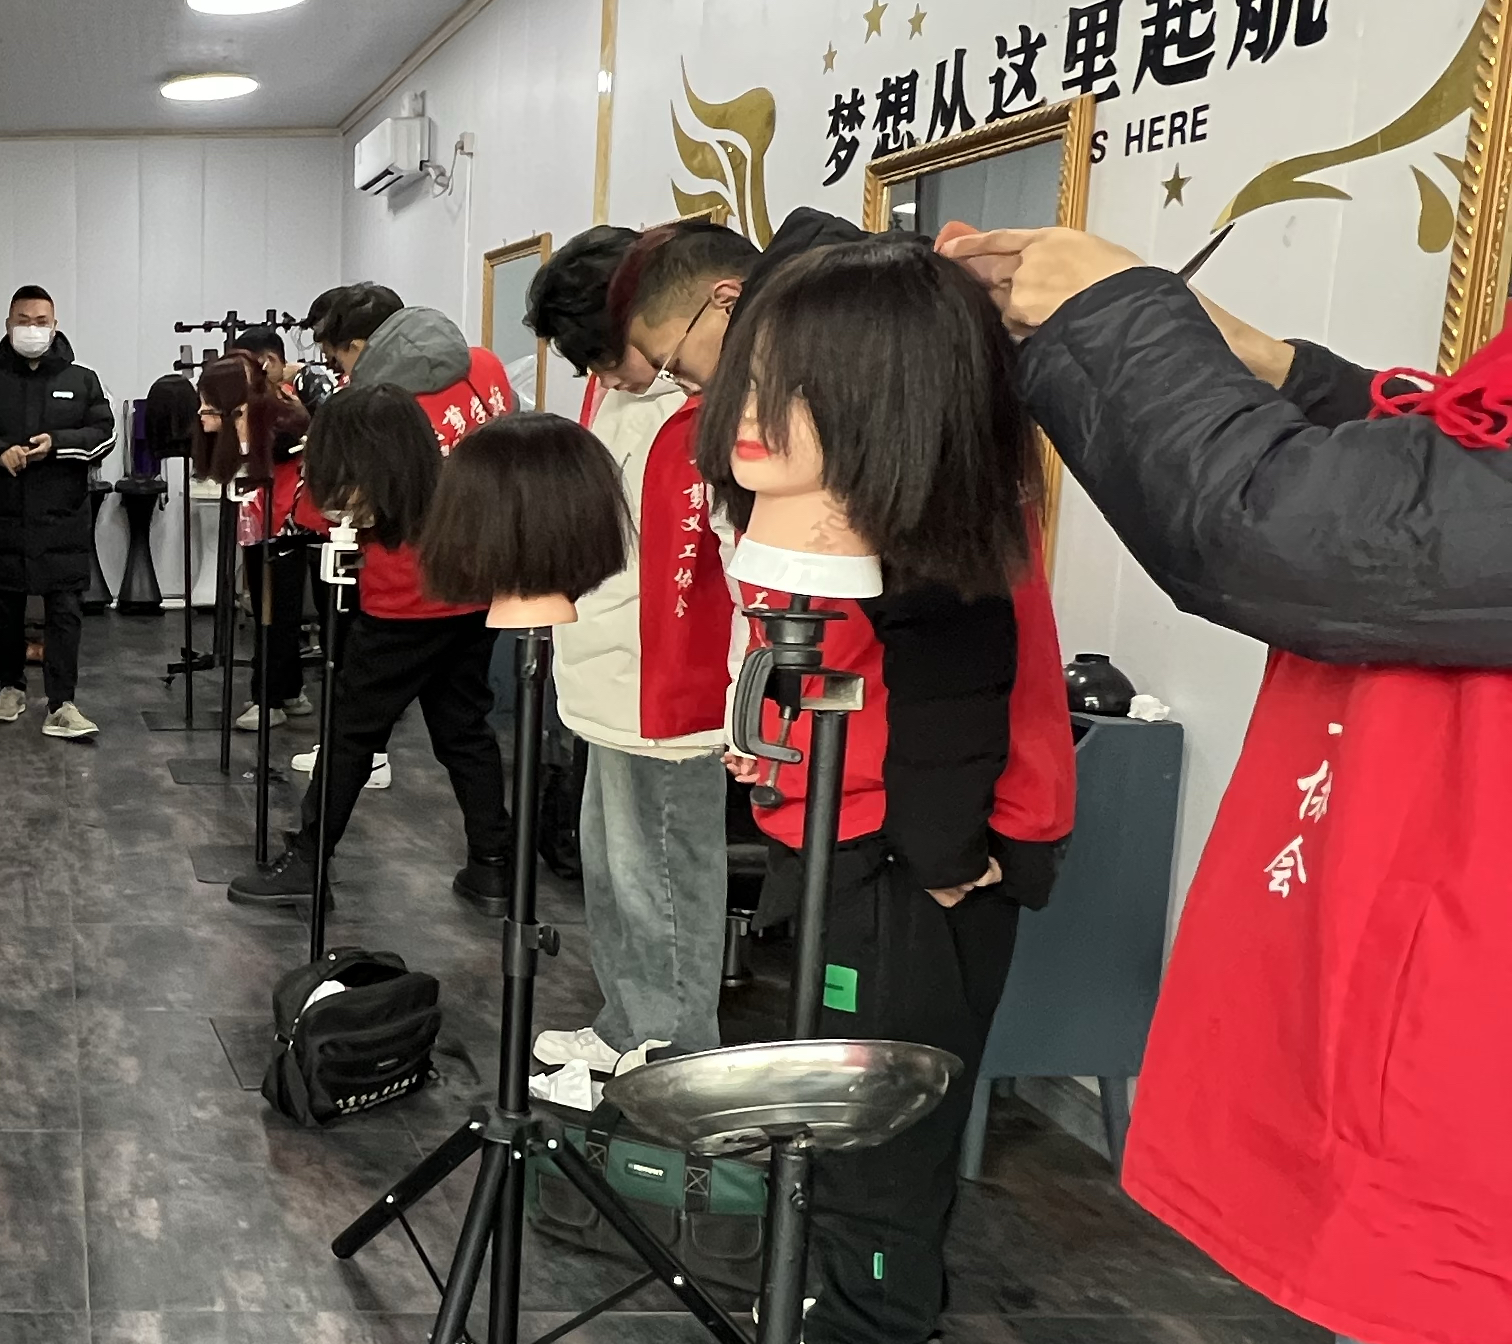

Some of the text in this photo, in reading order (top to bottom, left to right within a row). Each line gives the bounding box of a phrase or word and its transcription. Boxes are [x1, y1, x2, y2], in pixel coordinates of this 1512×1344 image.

[1125, 104, 1210, 157] HERE
[674, 459, 705, 619] 剪义工协会
[1263, 722, 1344, 898] 协会
